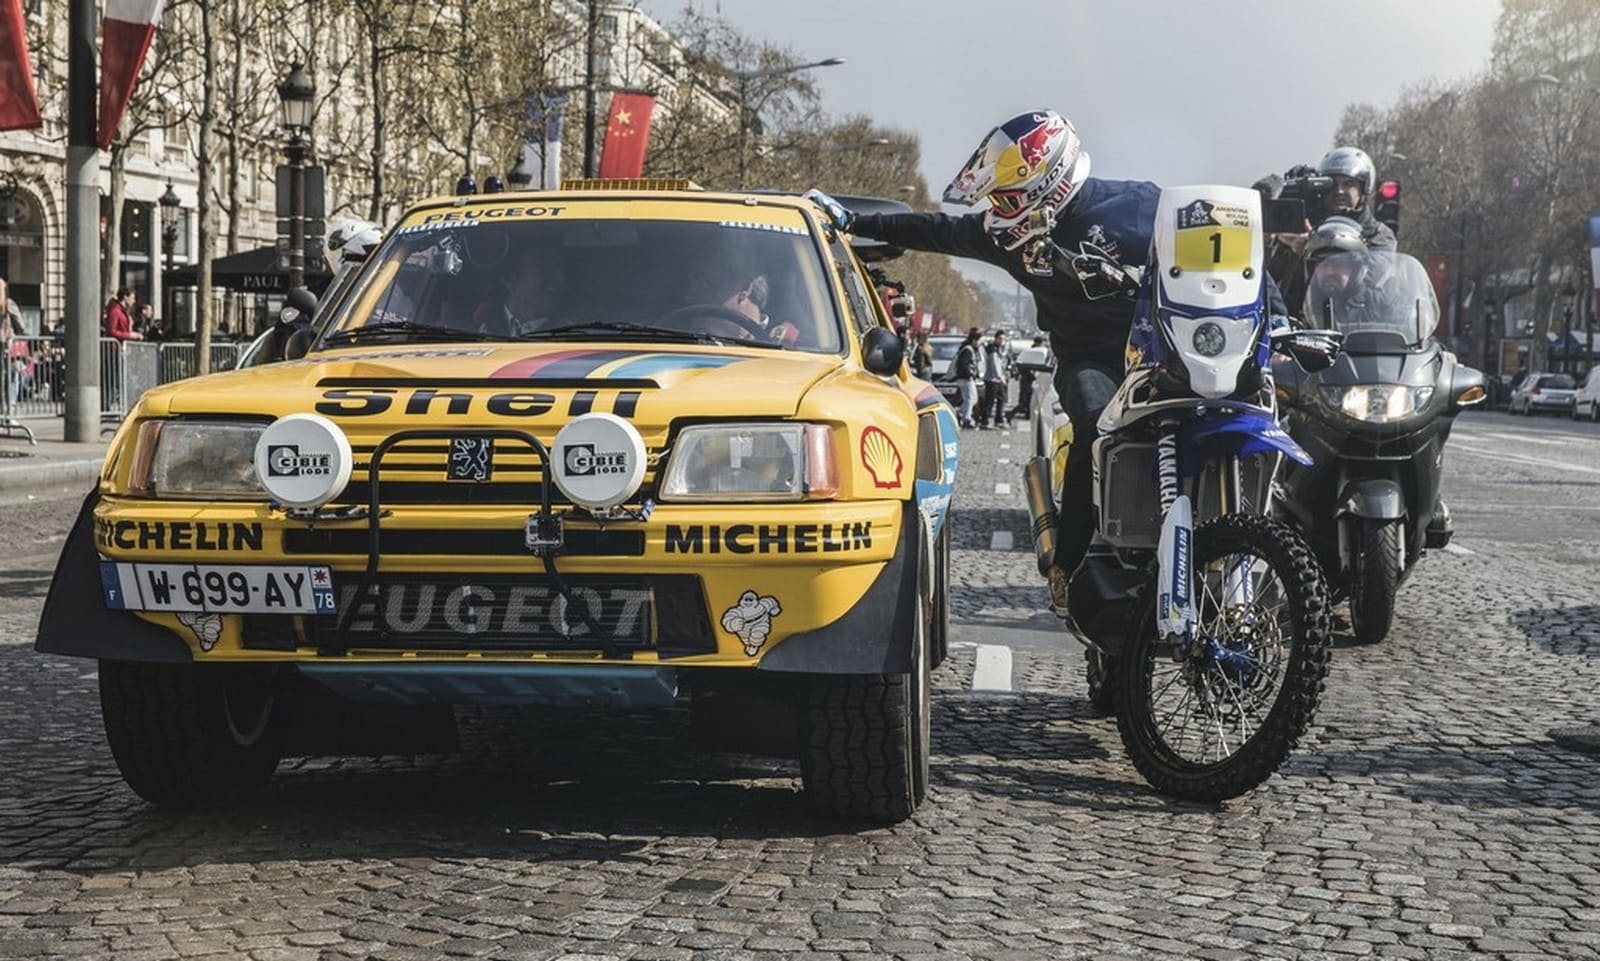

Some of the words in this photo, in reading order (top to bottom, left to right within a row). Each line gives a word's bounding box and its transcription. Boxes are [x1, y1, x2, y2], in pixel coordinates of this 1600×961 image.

[1026, 157, 1066, 201] RUDY
[424, 206, 566, 225] PEUGEOT
[1209, 232, 1222, 264] 1
[243, 275, 281, 288] PAUL
[314, 388, 642, 419] Shell
[664, 521, 873, 555] MICHELIN
[1176, 528, 1189, 599] MICHELIN
[108, 590, 116, 601] F
[148, 569, 305, 608] W-699-AY
[315, 592, 335, 609] 78
